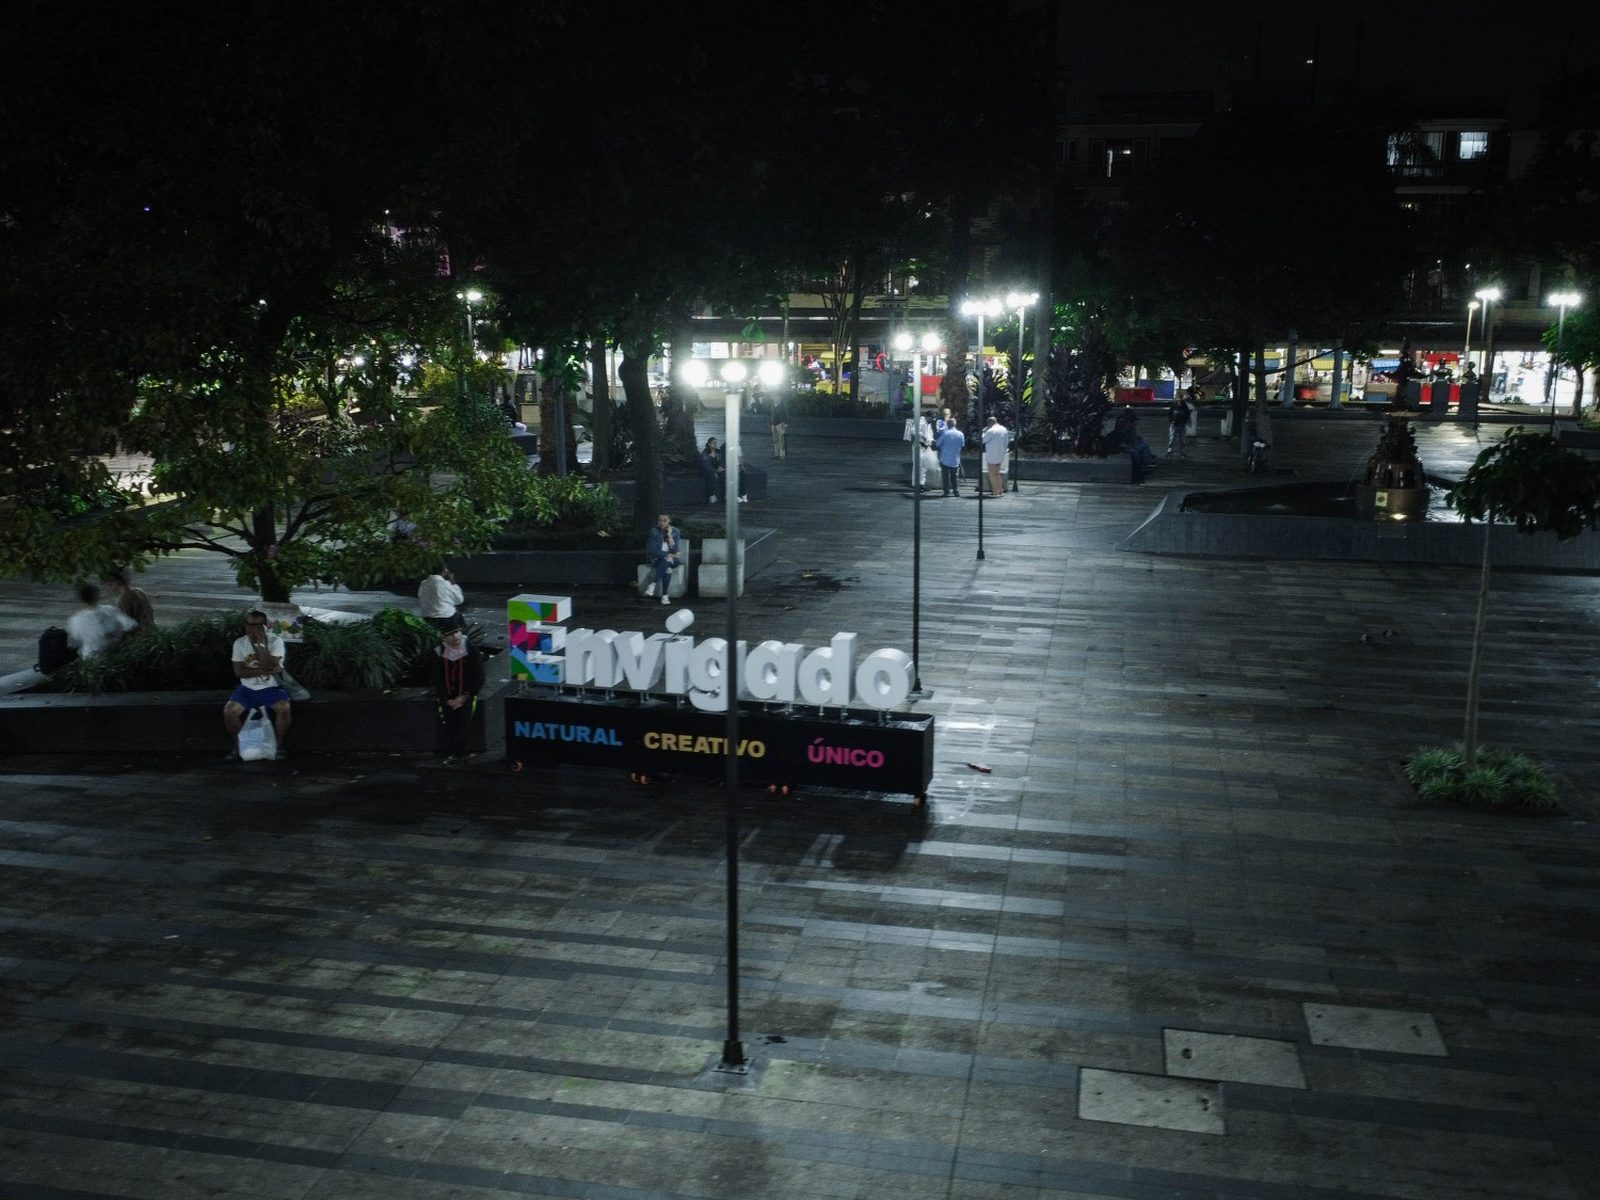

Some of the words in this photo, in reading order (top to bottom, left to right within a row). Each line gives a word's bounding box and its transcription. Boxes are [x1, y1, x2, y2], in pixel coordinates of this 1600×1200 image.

[507, 594, 915, 712] Envigado
[514, 720, 623, 747] NATURAL
[643, 731, 767, 758] CREATIVO
[807, 737, 885, 769] ÚNICO
